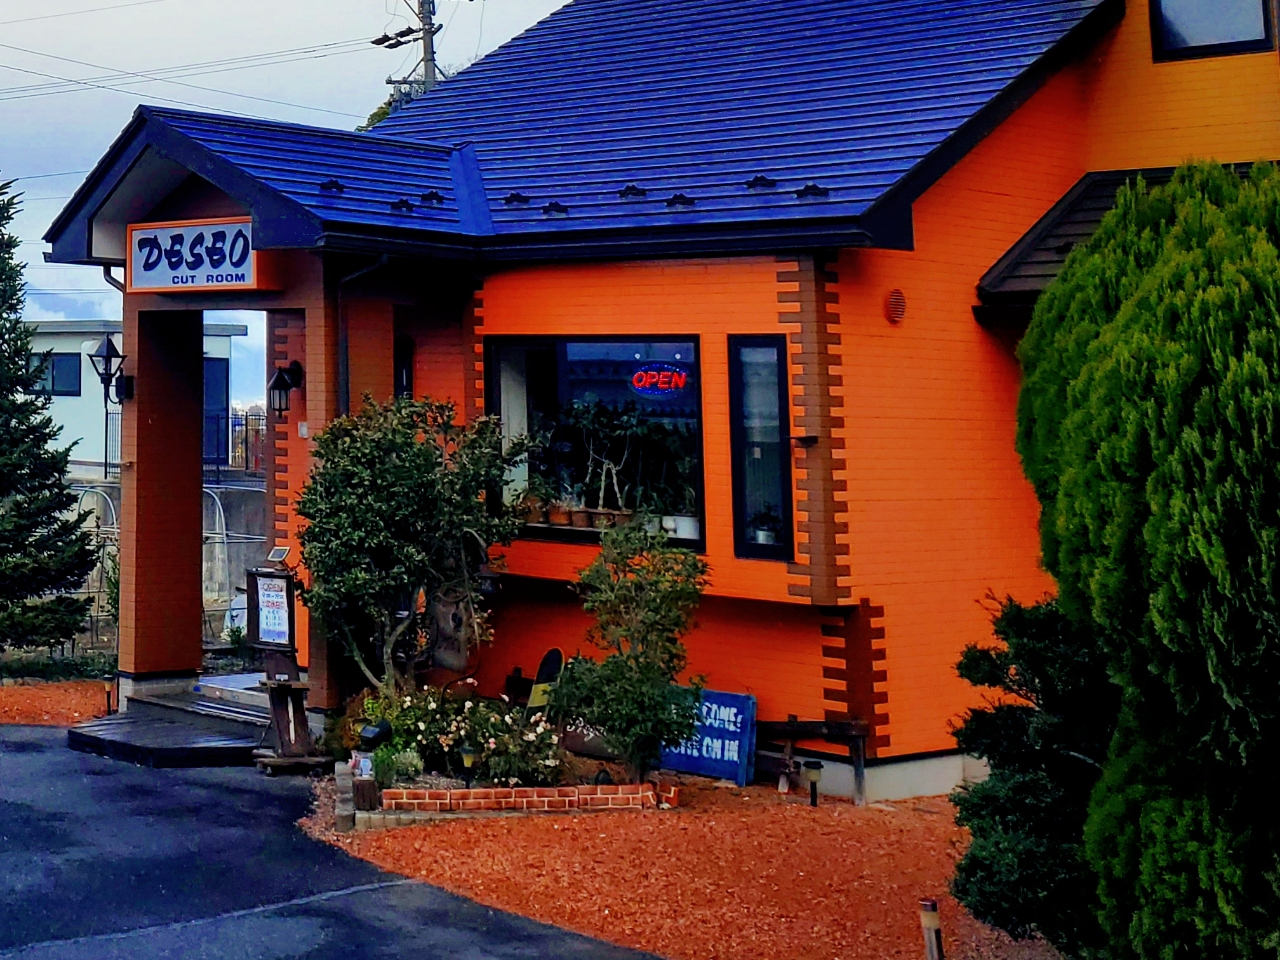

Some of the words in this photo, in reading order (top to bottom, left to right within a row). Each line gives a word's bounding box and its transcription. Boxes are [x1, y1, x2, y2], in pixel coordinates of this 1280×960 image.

[138, 229, 250, 272] DESEO
[172, 274, 196, 285] CUT
[206, 273, 246, 283] ROOM
[632, 371, 687, 389] OPEN
[702, 737, 722, 759] ON
